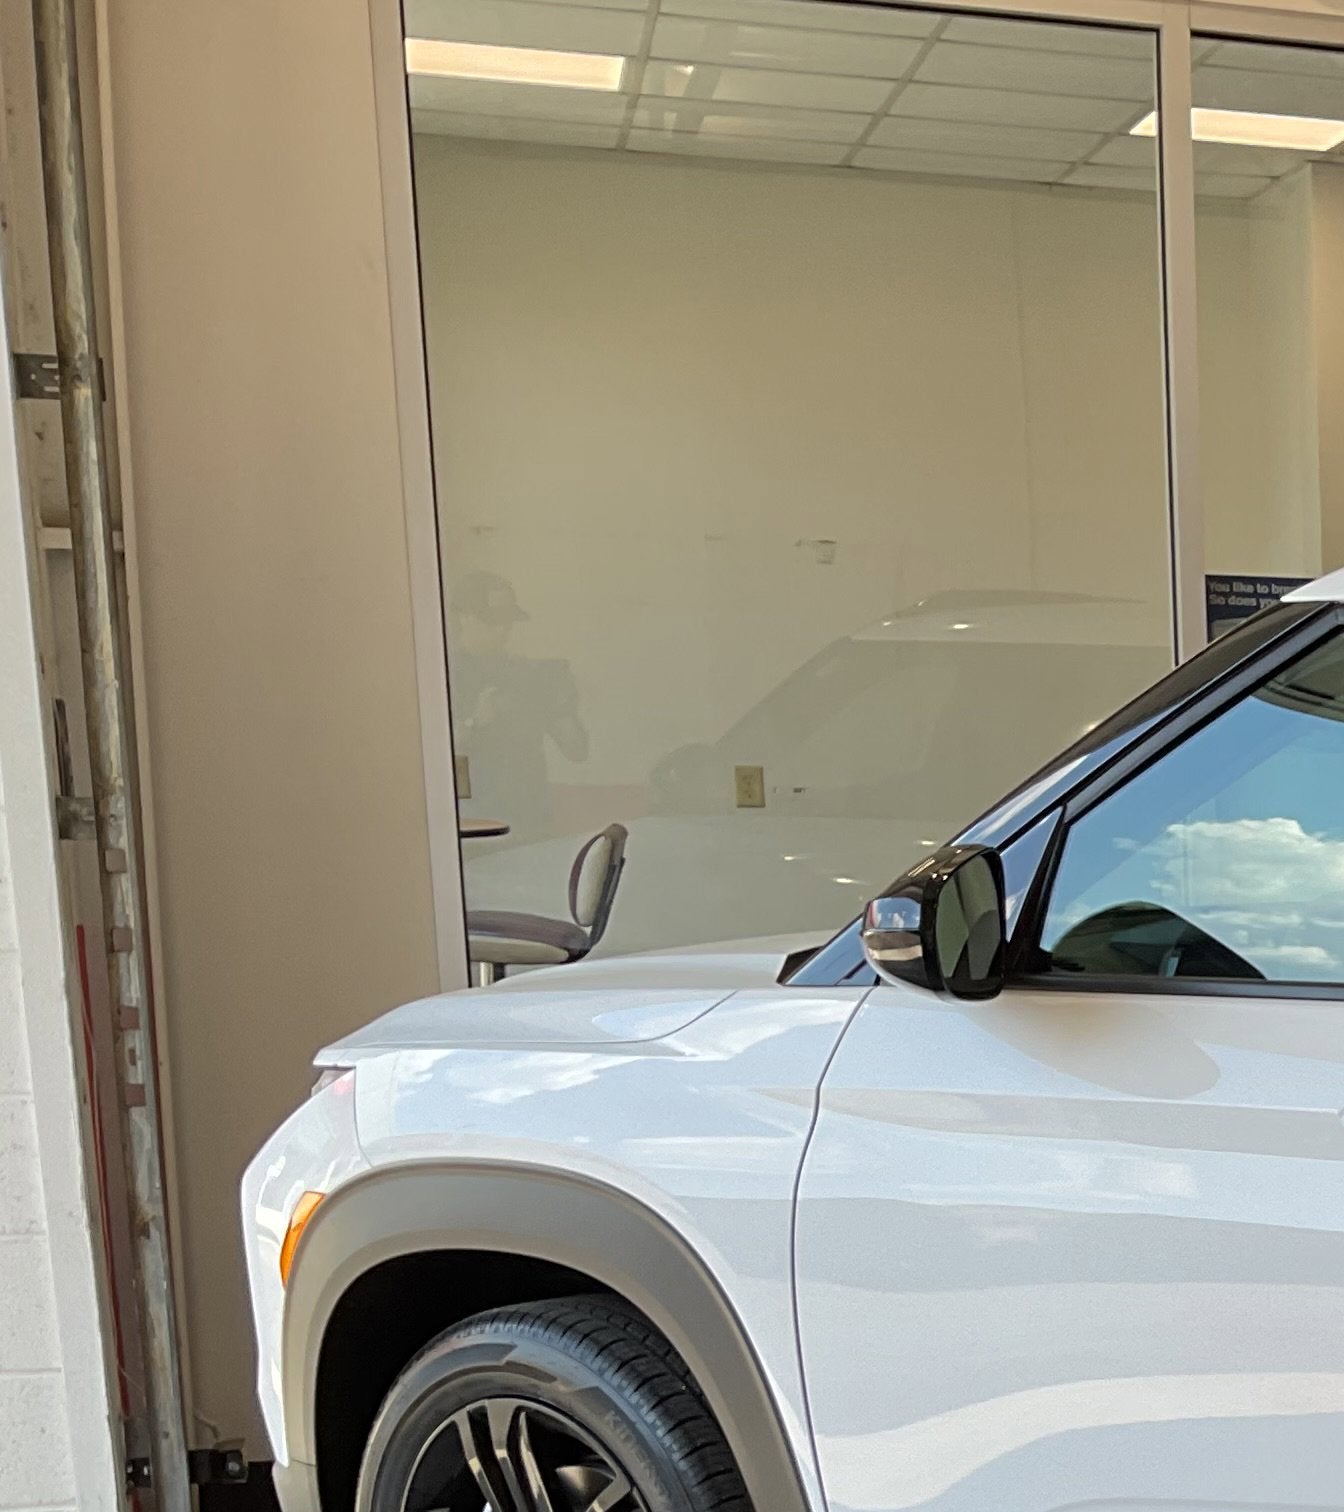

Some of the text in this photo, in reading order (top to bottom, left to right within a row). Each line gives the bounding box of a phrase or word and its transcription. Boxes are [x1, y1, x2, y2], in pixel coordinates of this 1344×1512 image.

[1209, 581, 1230, 593] You
[1257, 582, 1269, 594] to
[1209, 594, 1226, 606] So
